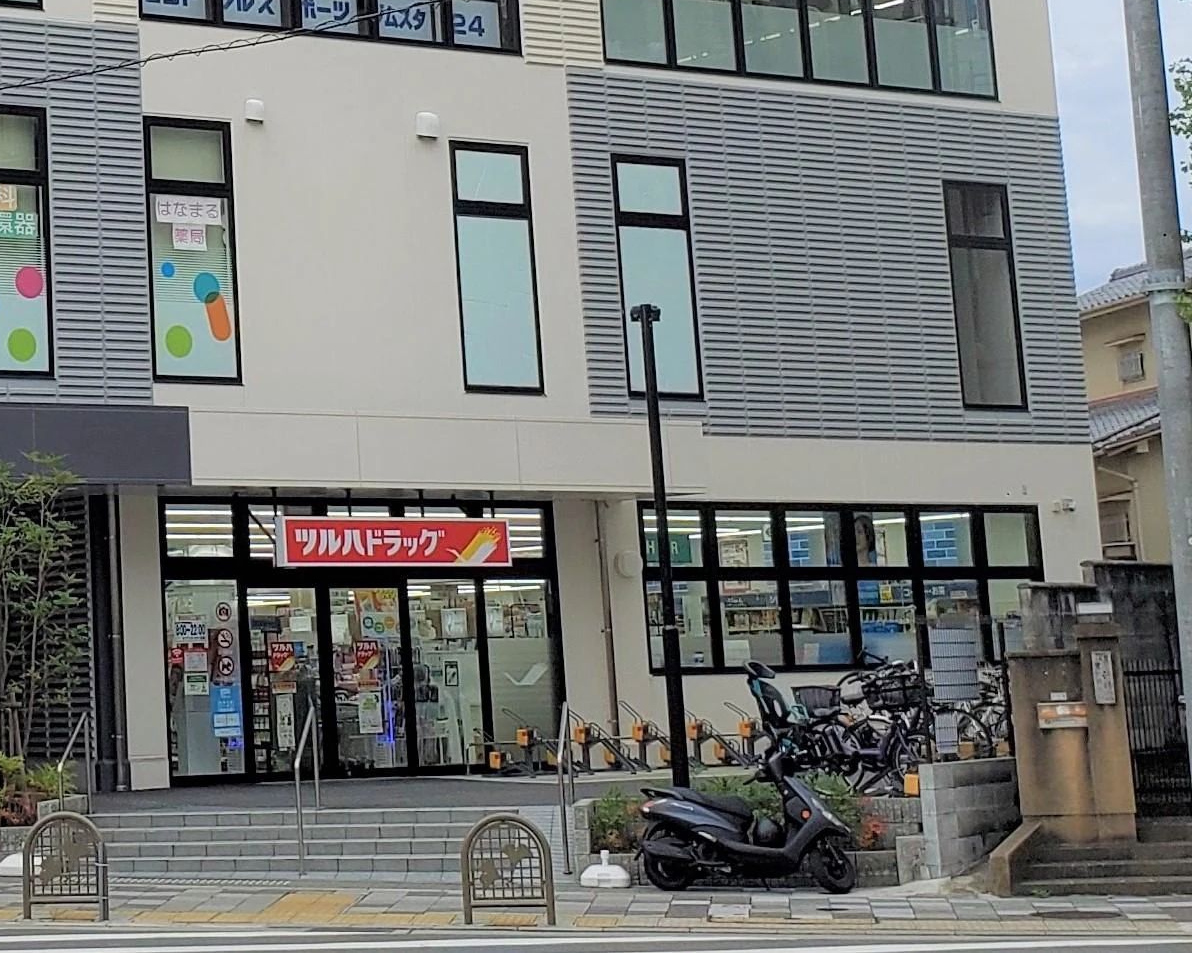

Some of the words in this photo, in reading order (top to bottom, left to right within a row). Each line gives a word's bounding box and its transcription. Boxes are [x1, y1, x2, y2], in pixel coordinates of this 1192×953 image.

[156, 199, 219, 220] はなまる
[174, 228, 206, 246] 薬局
[295, 528, 445, 556] ツルハドラッグ
